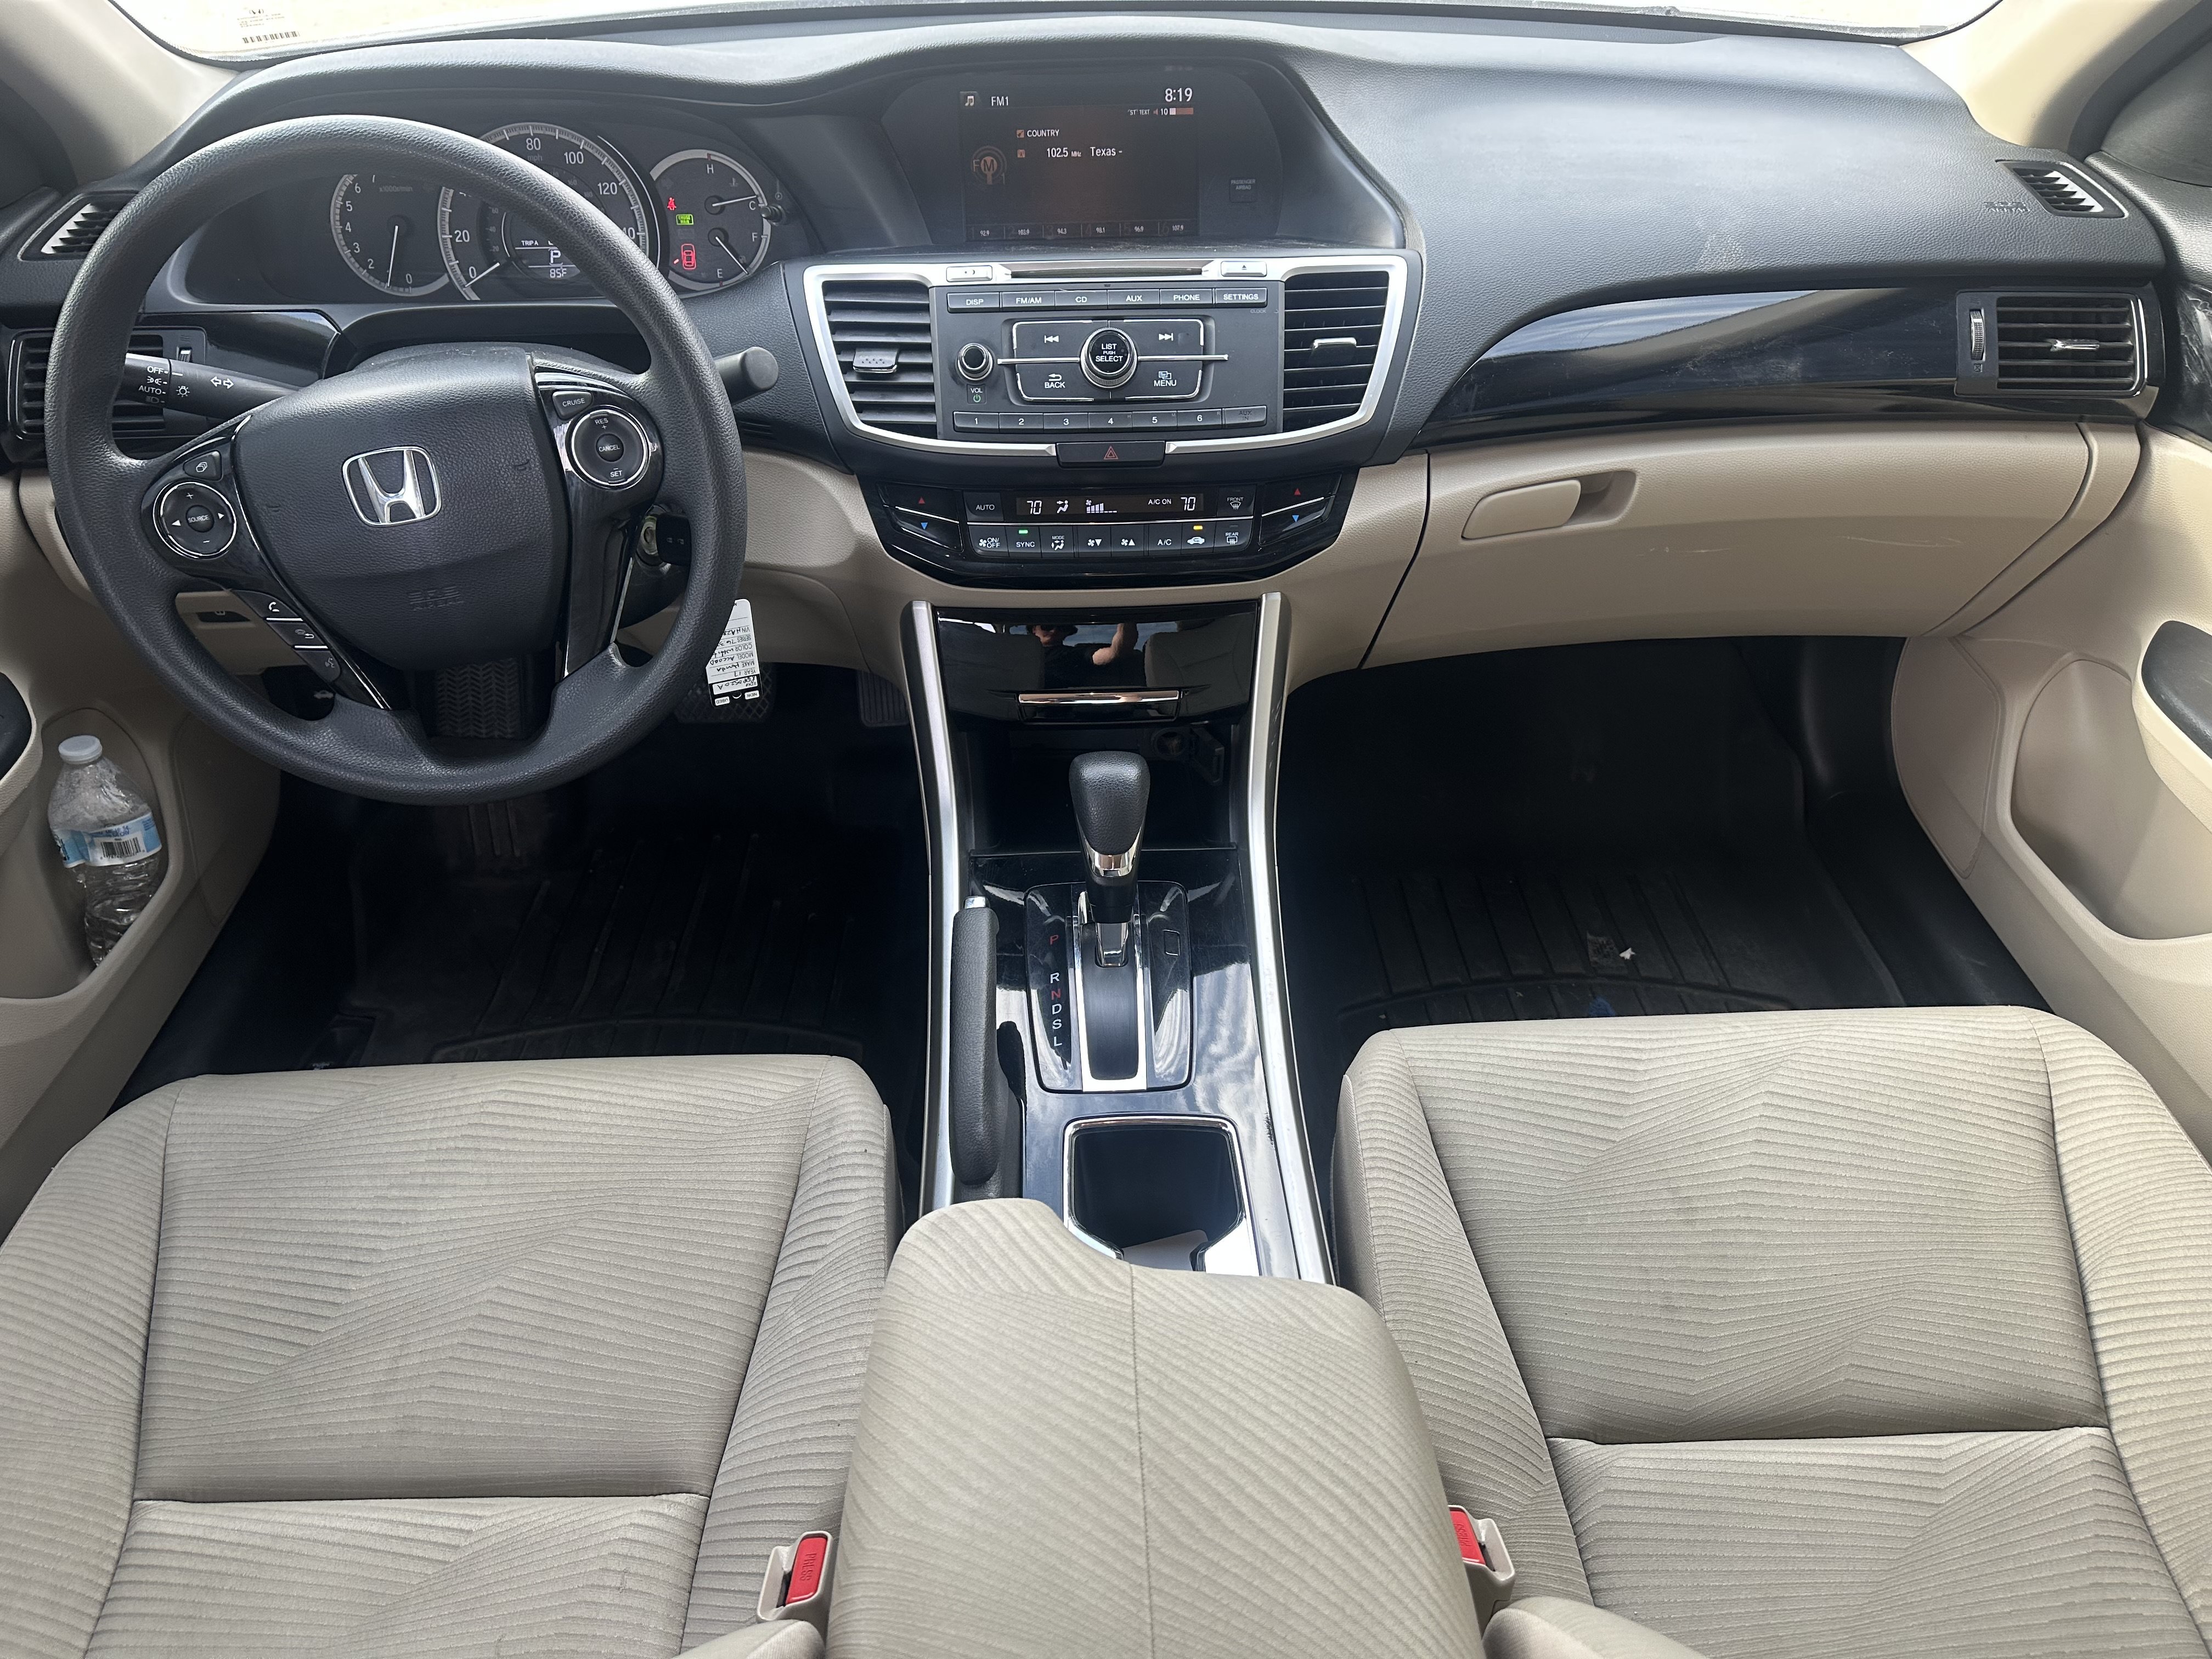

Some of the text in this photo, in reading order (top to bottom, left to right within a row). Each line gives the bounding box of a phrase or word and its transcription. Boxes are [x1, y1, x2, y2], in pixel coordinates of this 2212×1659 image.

[1165, 87, 1193, 102] 8:19
[991, 96, 1009, 106] FM1
[1027, 129, 1059, 137] COUNTRY
[526, 138, 541, 150] 80
[1047, 148, 1068, 157] 102.5
[1090, 146, 1116, 157] Texas
[564, 151, 584, 165] 100
[707, 164, 714, 174] H
[354, 183, 361, 194] 6
[597, 182, 618, 195] 120
[346, 200, 353, 212] 5
[749, 201, 756, 211] C
[345, 222, 352, 233] 4
[454, 229, 470, 242] 20
[752, 233, 758, 241] F
[353, 242, 360, 253] 3
[550, 250, 561, 263] P
[368, 258, 375, 269] 2
[406, 273, 413, 284] 0
[469, 267, 476, 279] 0
[717, 268, 723, 278] E
[147, 366, 164, 374] OFF
[1044, 381, 1065, 390] BACK
[1154, 379, 1177, 387] MENU
[138, 386, 162, 396] AUTO
[562, 398, 585, 407] CRUISE
[1026, 500, 1042, 515] 70
[1181, 496, 1196, 511] 70
[187, 514, 210, 523] SOURCE
[737, 635, 752, 643] SERIES
[735, 644, 753, 652] COLOR
[737, 651, 753, 660] MODEL
[744, 668, 756, 676] YEAR
[1049, 934, 1059, 945] P
[1050, 972, 1060, 984] R
[1051, 990, 1061, 1000] N
[1052, 1003, 1062, 1014] D
[1052, 1019, 1062, 1030] S
[1053, 1036, 1063, 1047] L
[799, 1552, 817, 1581] PRESS
